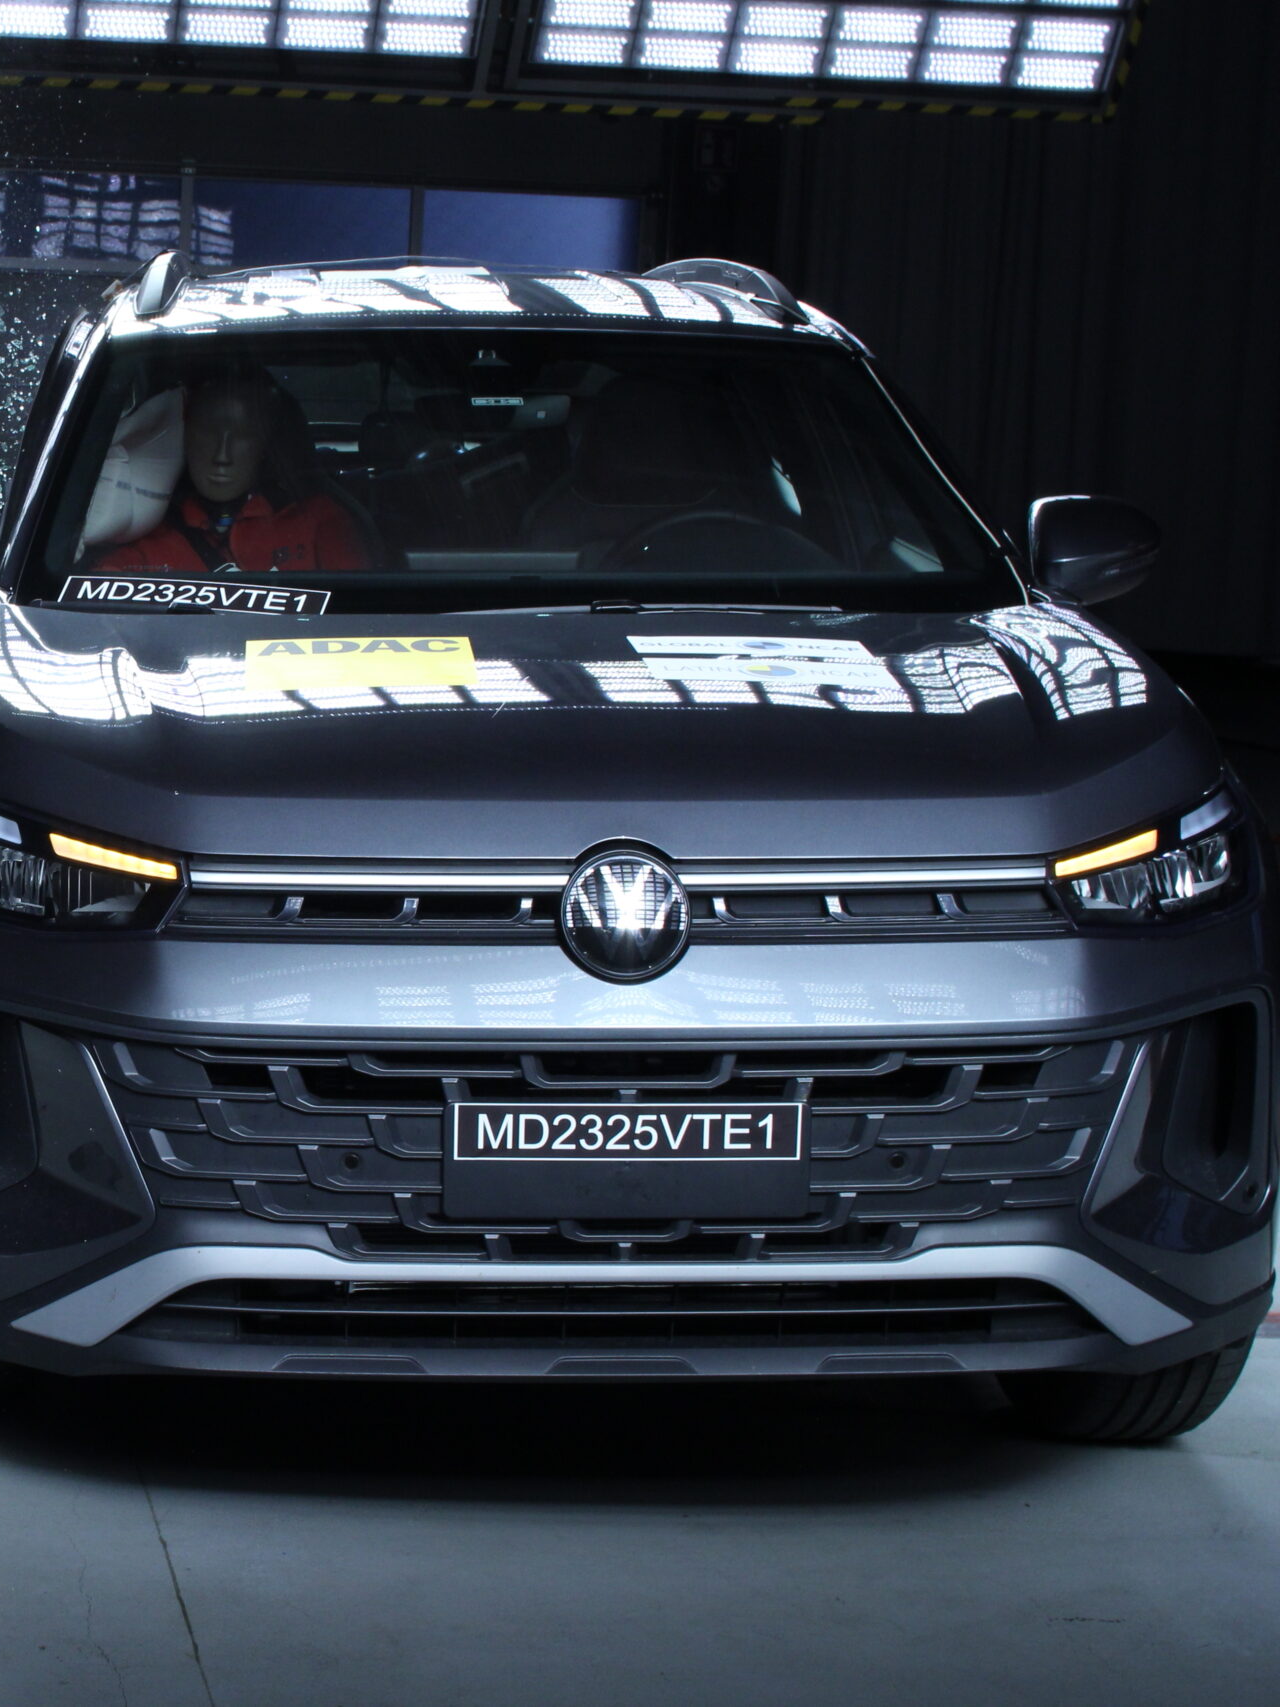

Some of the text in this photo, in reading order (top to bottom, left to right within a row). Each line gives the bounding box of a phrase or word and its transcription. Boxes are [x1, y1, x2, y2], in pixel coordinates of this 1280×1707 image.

[76, 580, 309, 613] MD2325VTE1
[257, 639, 461, 656] ADAC
[797, 643, 861, 652] NCAP
[662, 664, 879, 677] LATIN NCAP
[477, 1113, 775, 1150] MD2325VTE1
